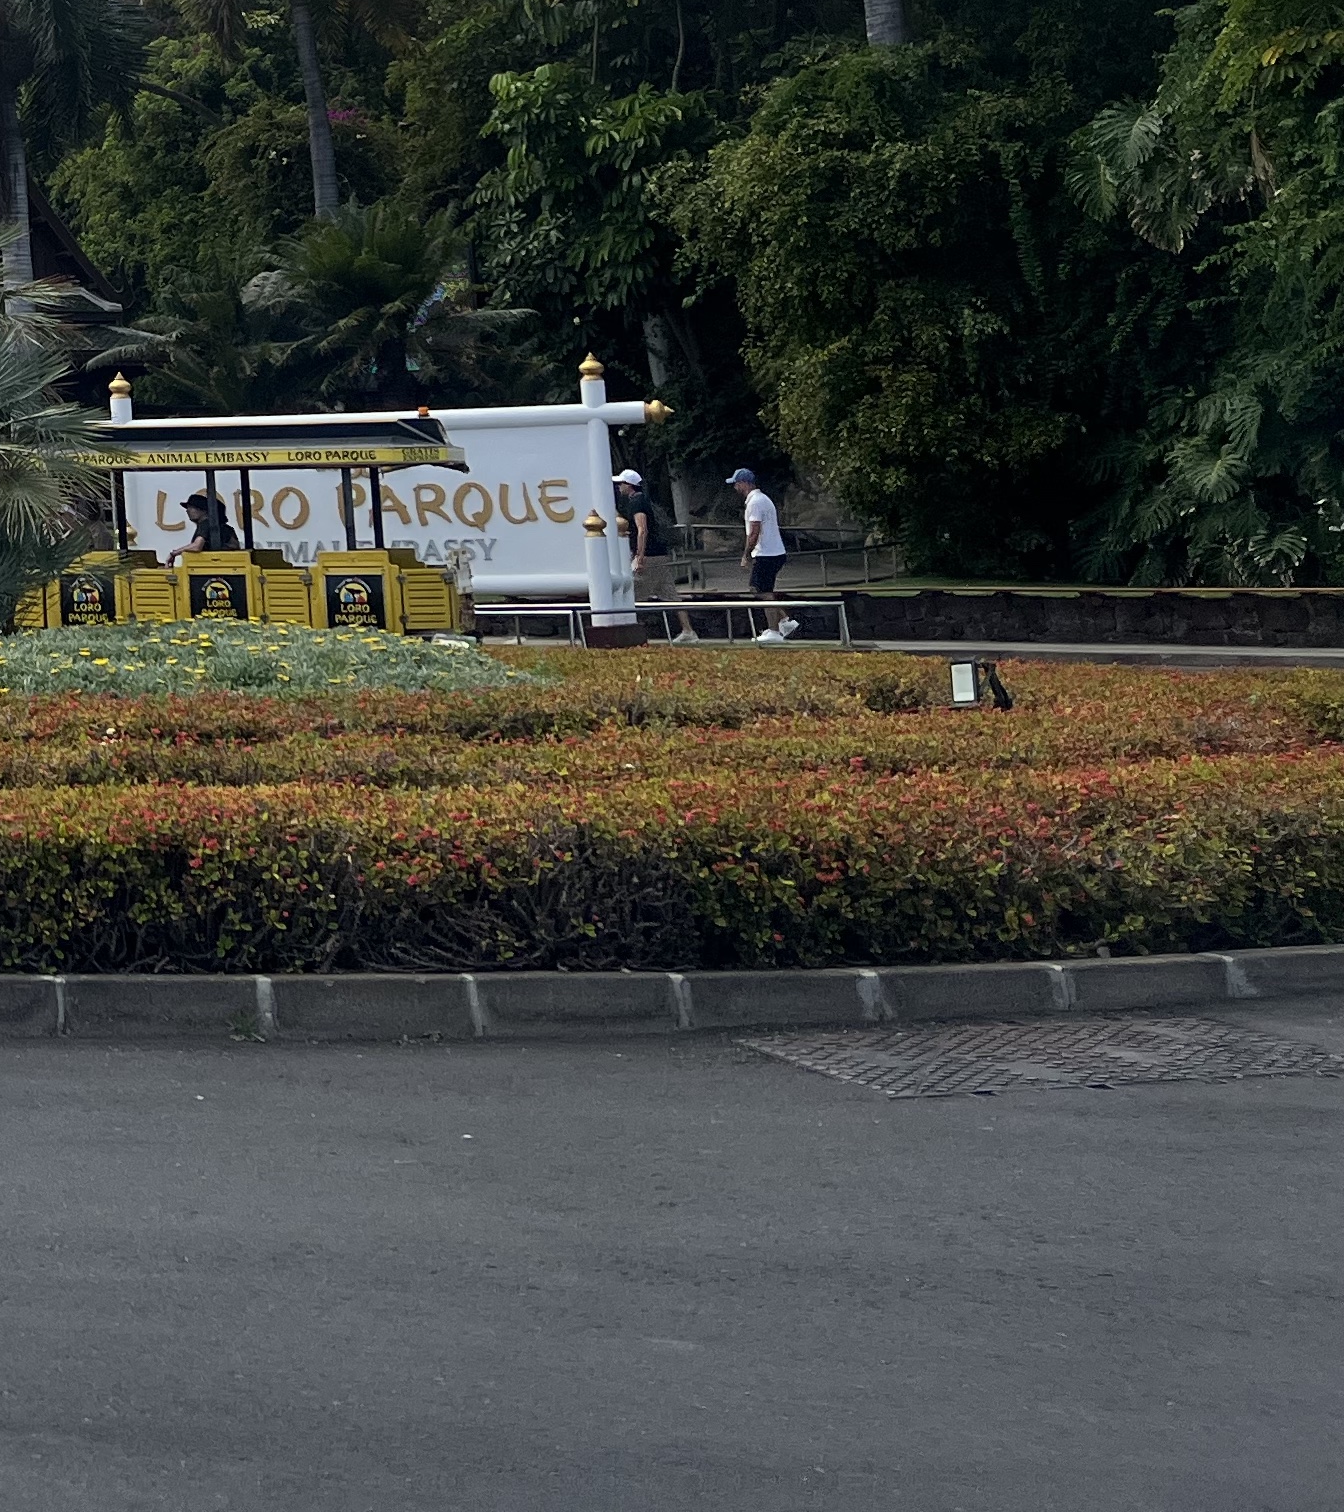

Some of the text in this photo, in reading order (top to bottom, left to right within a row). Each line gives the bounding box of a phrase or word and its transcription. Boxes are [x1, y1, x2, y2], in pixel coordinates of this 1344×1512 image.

[146, 451, 270, 464] ANIMAL EMBASSY
[288, 450, 377, 461] LORO PARQUE
[155, 479, 575, 532] LRO PARQUE
[73, 603, 101, 612] LORO
[340, 604, 370, 613] LORO
[334, 614, 378, 625] PARQUE
